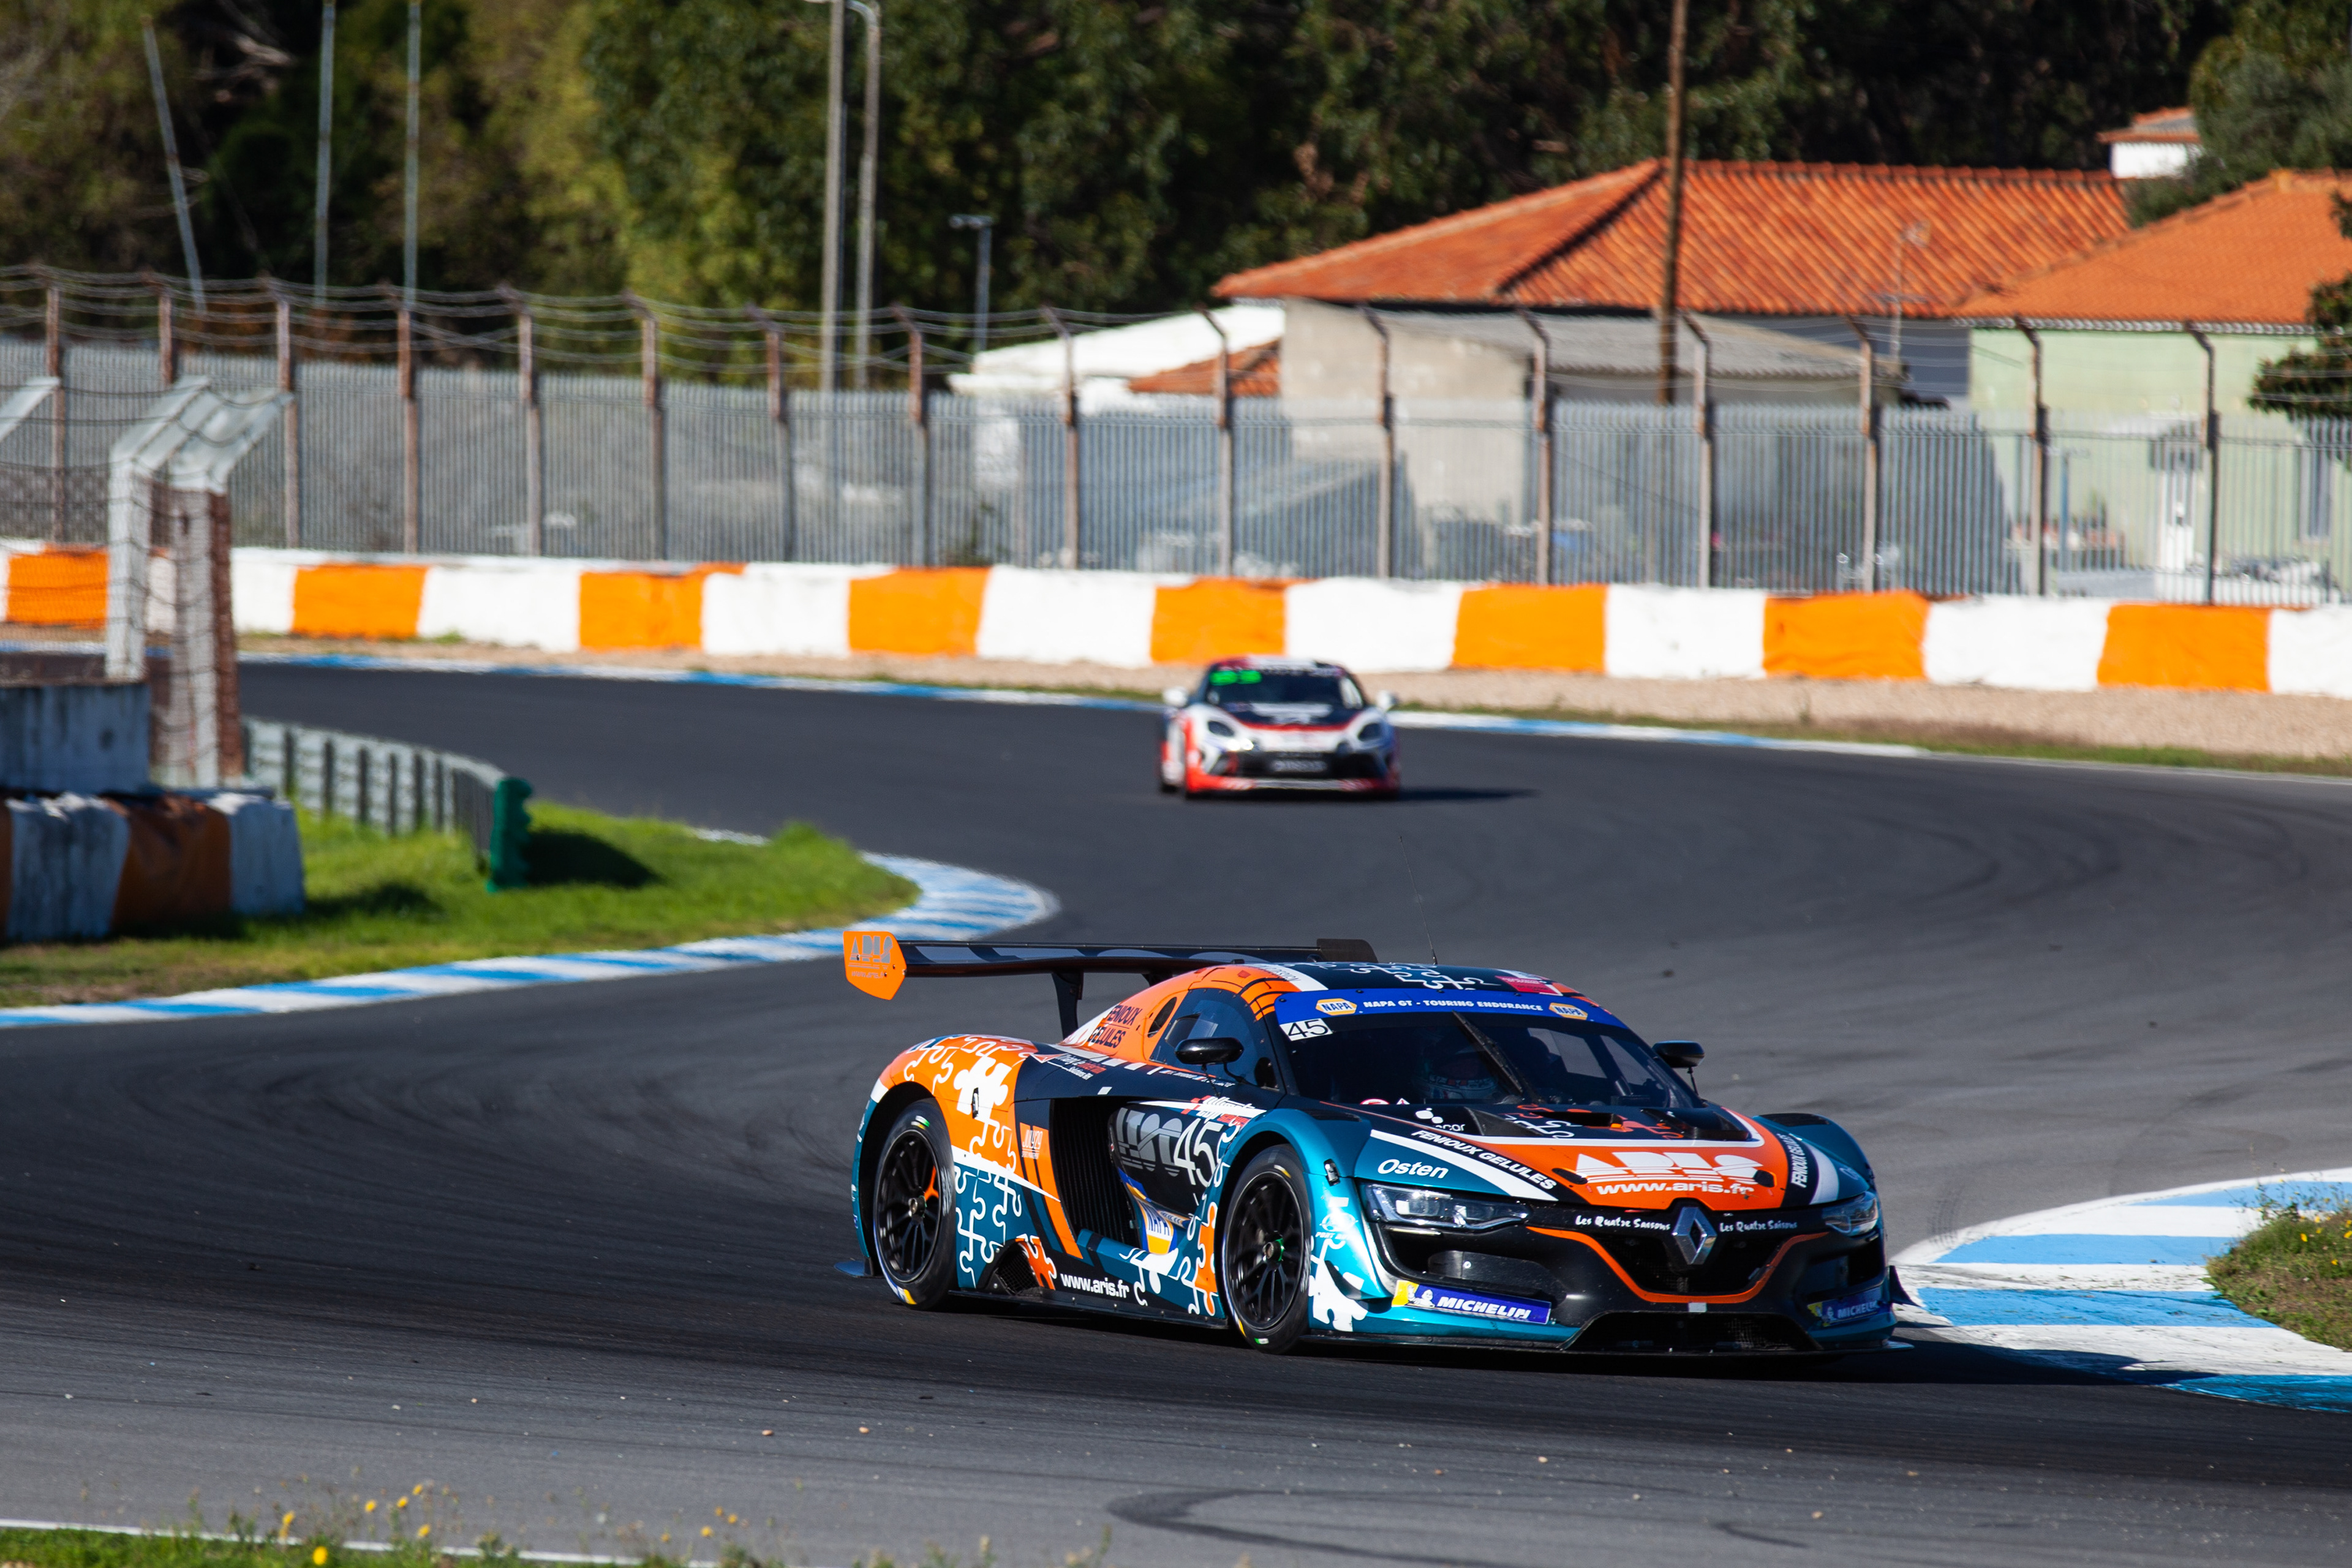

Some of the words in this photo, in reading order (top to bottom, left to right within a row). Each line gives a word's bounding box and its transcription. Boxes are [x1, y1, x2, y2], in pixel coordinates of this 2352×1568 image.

[1321, 1002, 1352, 1012] NAPA
[1477, 1001, 1544, 1011] ENDURANCE
[1554, 1006, 1584, 1016] NAPA
[1287, 1019, 1329, 1038] 45
[1173, 1118, 1224, 1187] 45
[1411, 1130, 1483, 1155] FENIOUX
[1479, 1152, 1558, 1189] GELULES
[1378, 1159, 1449, 1178] Osten
[1576, 1152, 1764, 1185] ARIS
[1790, 1154, 1808, 1188] FENIOUX
[1596, 1181, 1755, 1195] www.aris.fr
[1575, 1215, 1592, 1225] Les
[1719, 1223, 1734, 1232] Les
[1060, 1273, 1130, 1298] www.aris.fr
[1438, 1296, 1532, 1319] MICHELIN
